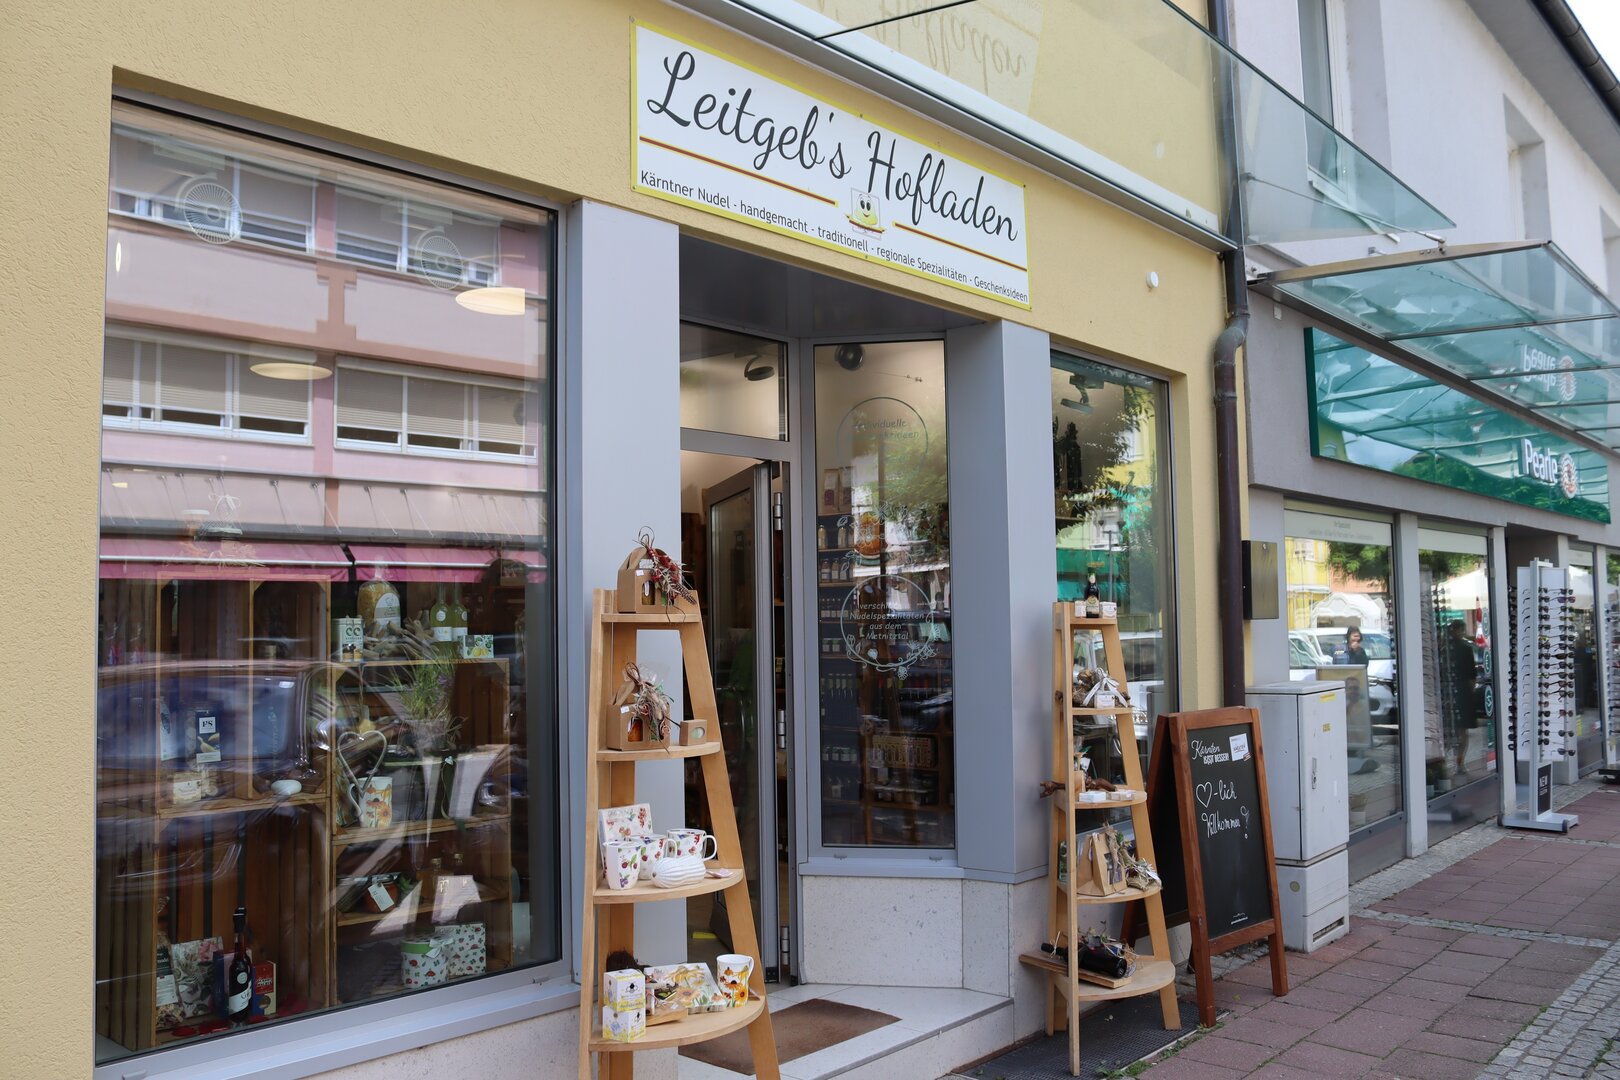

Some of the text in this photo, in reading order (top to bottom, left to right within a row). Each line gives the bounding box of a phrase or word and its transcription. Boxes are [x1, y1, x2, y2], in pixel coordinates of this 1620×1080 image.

[646, 50, 1018, 241] Leitgeb's Hofladen
[641, 170, 694, 197] Kärntner
[697, 186, 730, 209] Nudel
[740, 200, 808, 233] handgemacht
[818, 226, 869, 252] traditionell
[876, 246, 915, 266] regionale
[917, 256, 968, 283] Spezialitäten
[974, 276, 1028, 303] Geschenksideen
[1523, 439, 1558, 484] Pearle
[885, 622, 902, 630] dem
